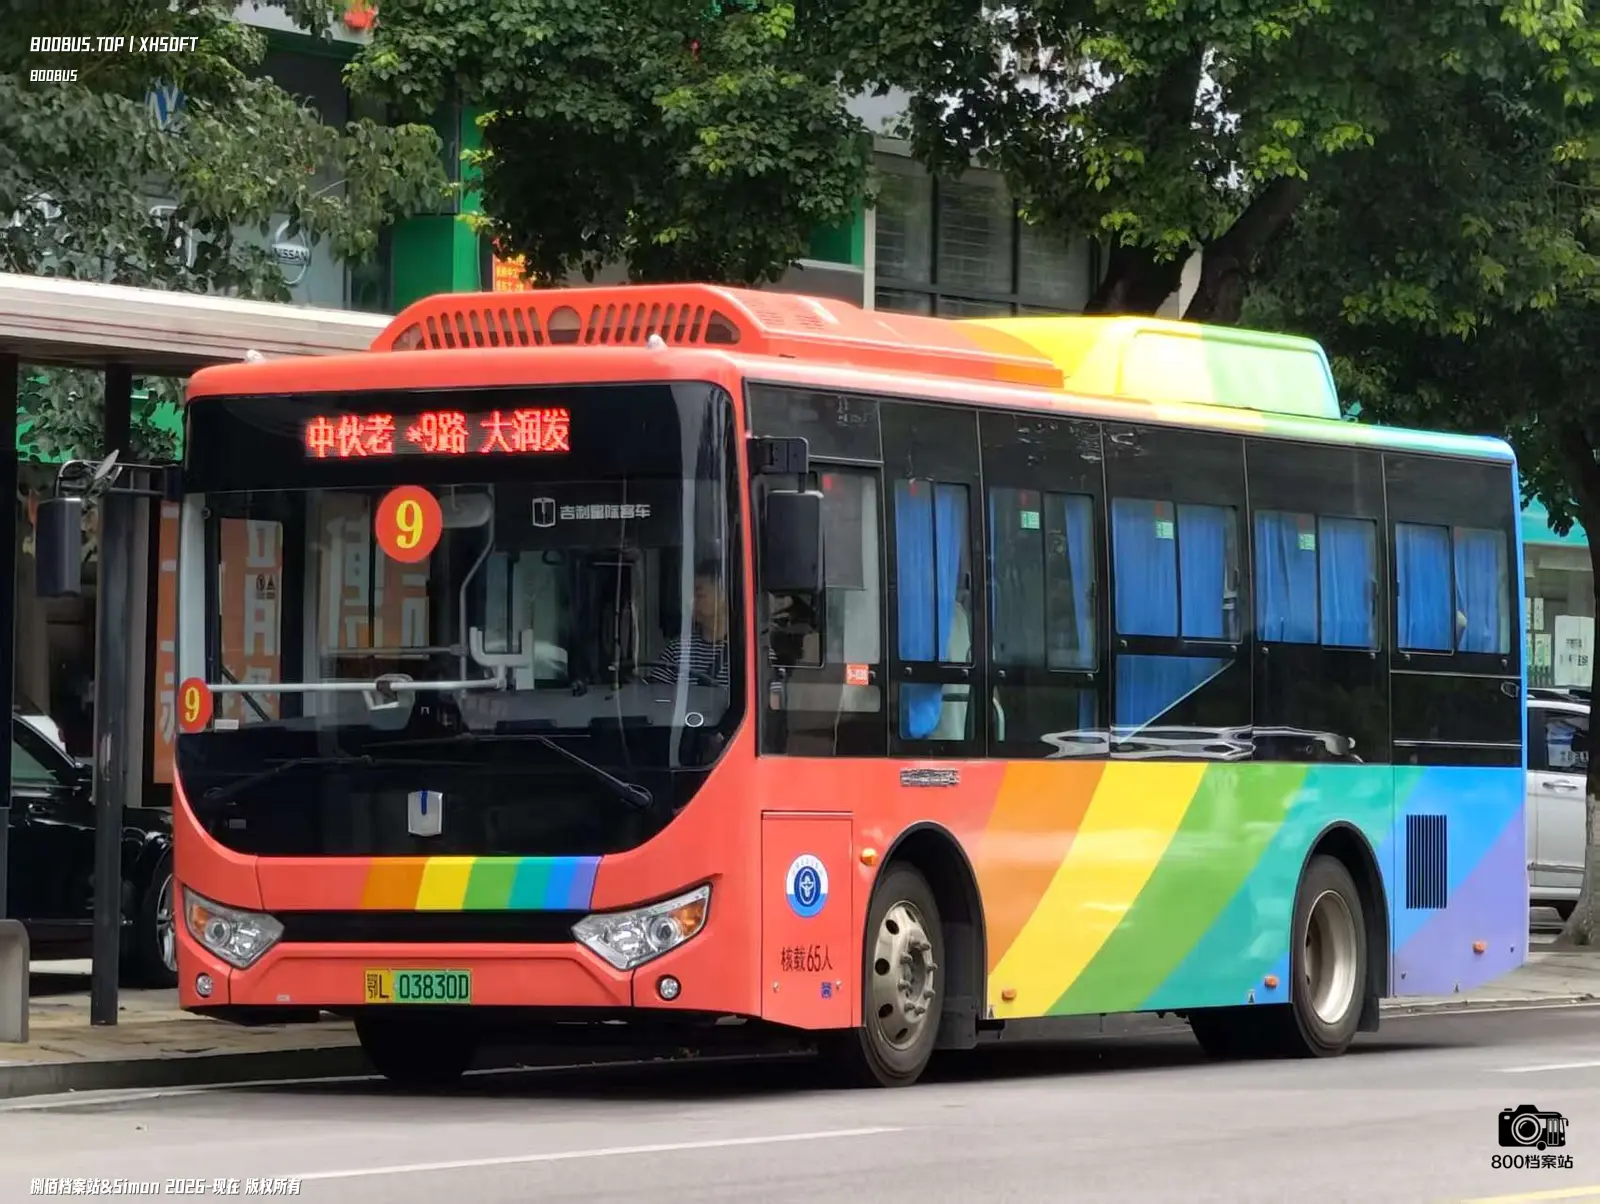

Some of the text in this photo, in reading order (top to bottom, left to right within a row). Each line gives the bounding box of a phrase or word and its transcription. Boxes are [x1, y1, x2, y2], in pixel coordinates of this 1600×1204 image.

[307, 413, 396, 458] 中伙老
[480, 408, 571, 454] 大润发
[396, 500, 423, 549] 9
[185, 686, 200, 722] 9
[780, 944, 833, 973] 核载65人
[399, 973, 469, 999] 03830D
